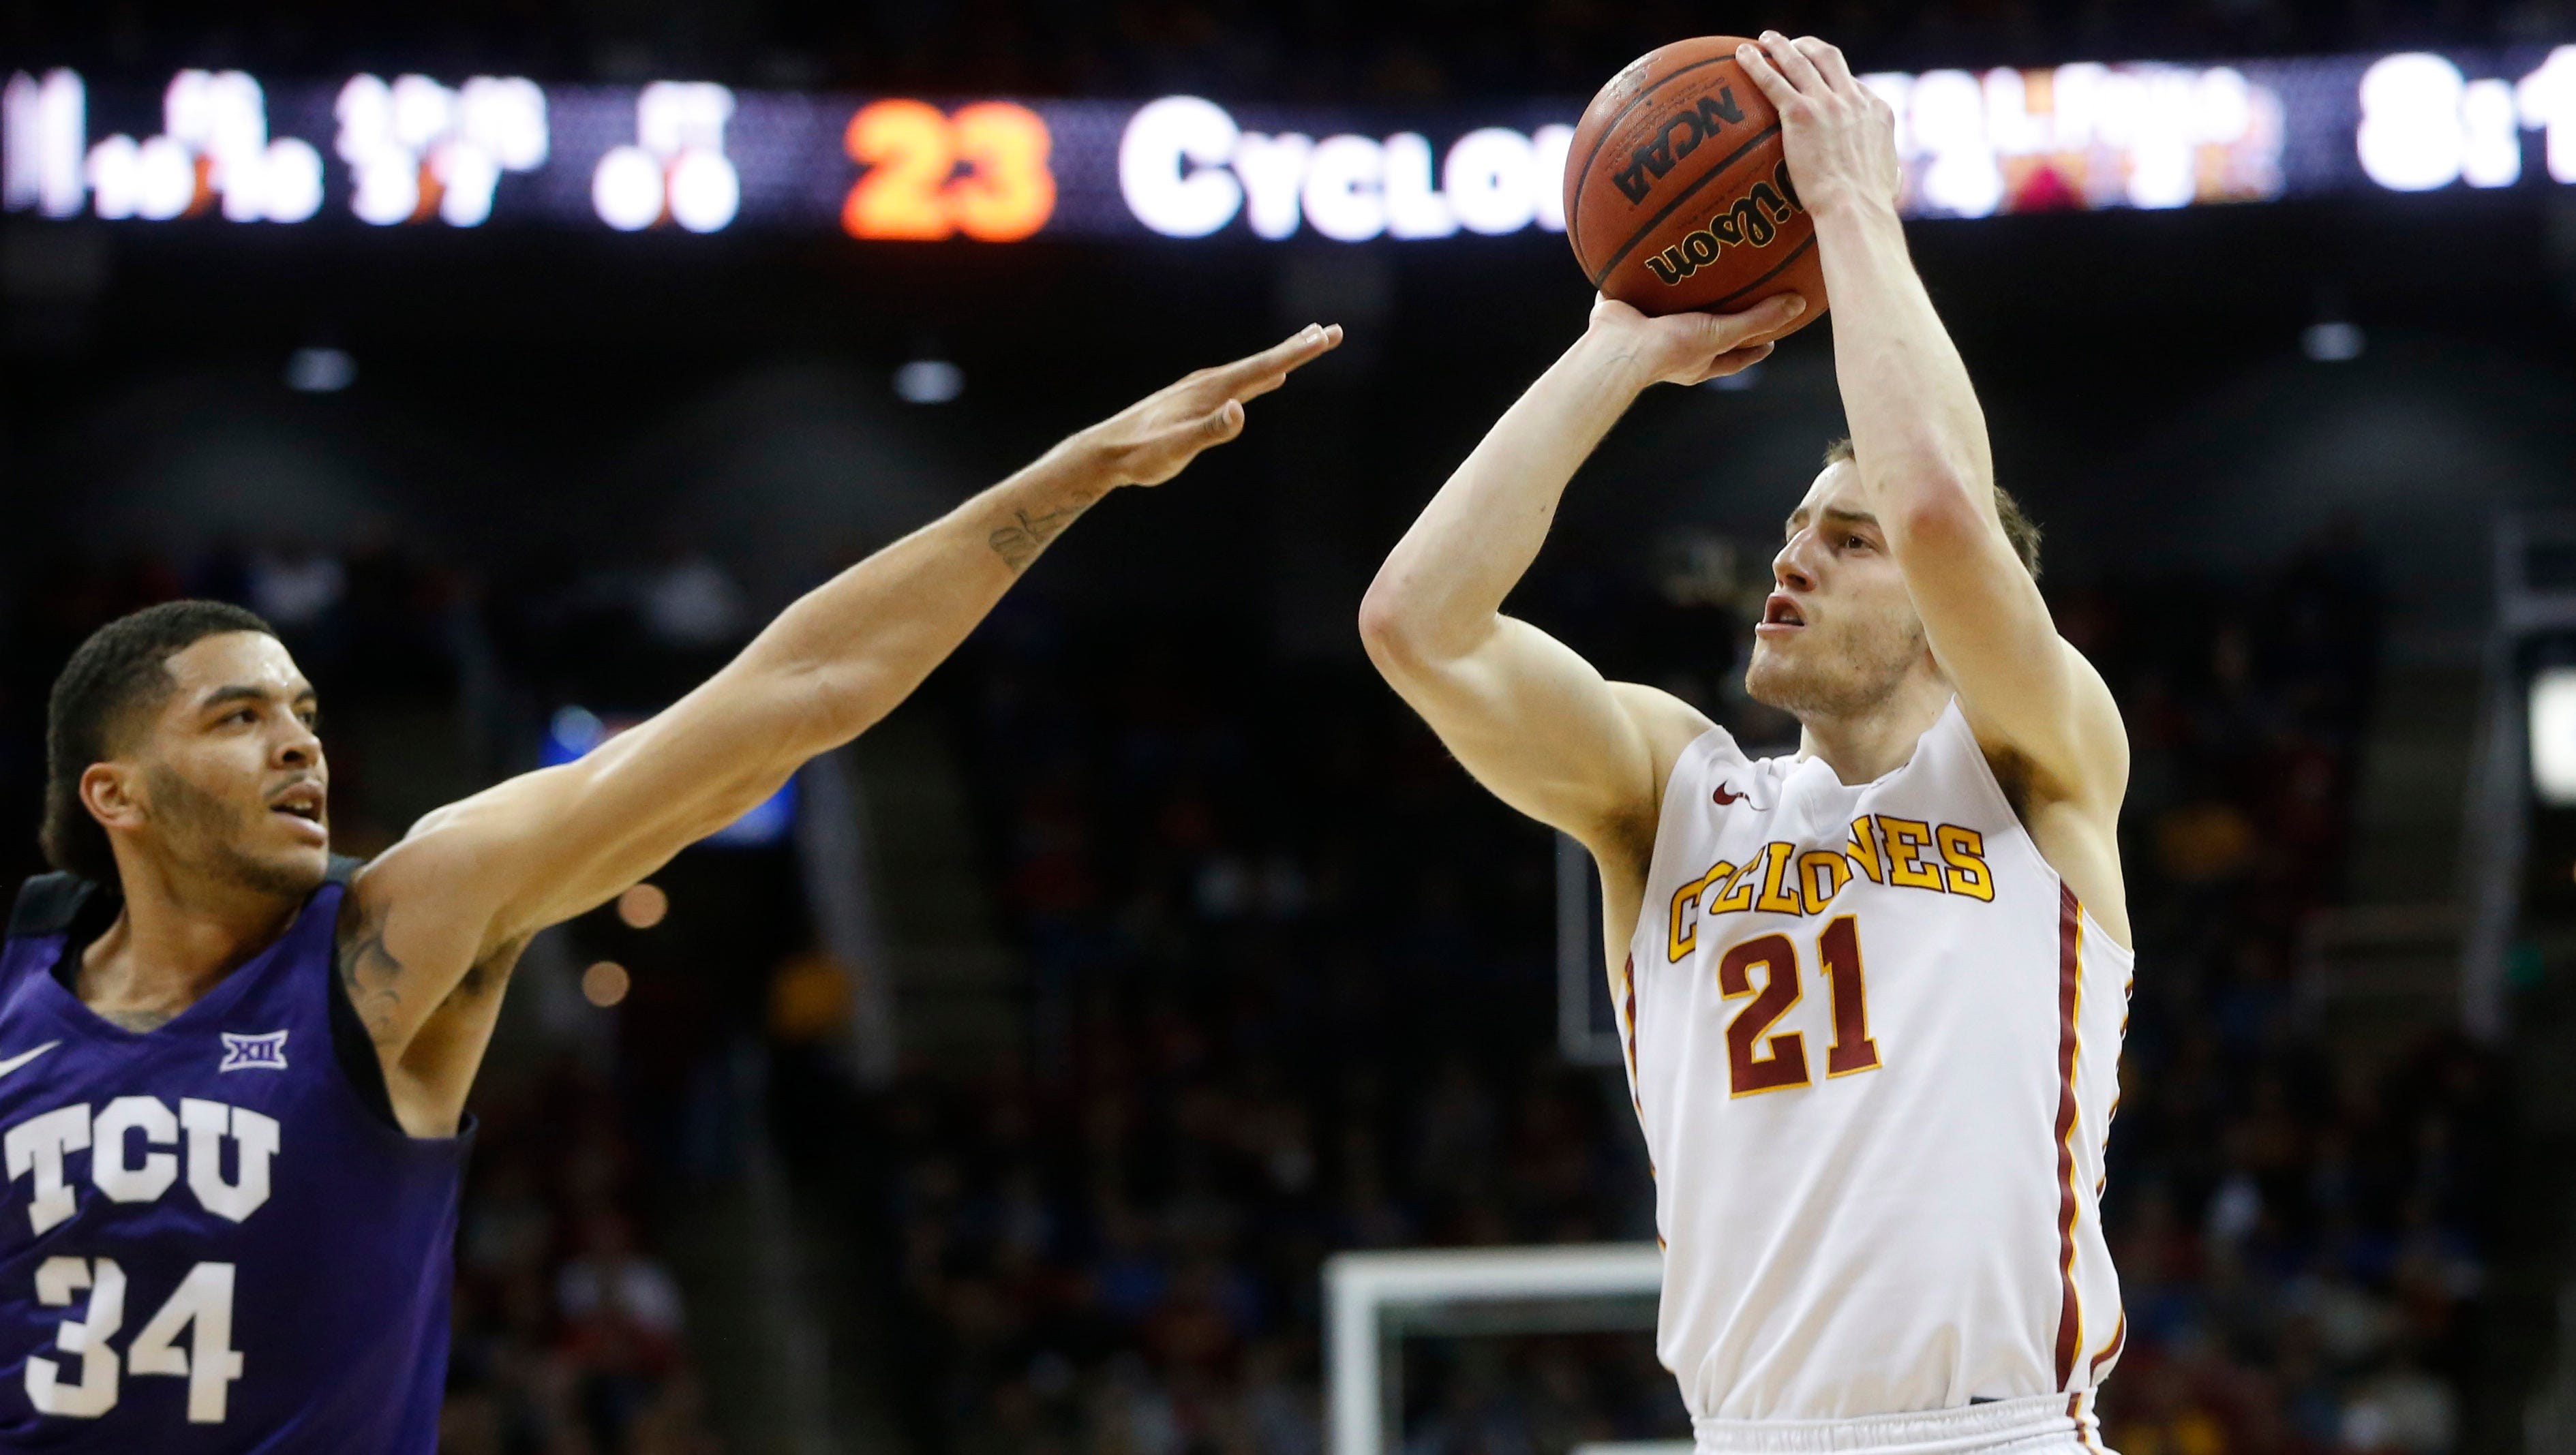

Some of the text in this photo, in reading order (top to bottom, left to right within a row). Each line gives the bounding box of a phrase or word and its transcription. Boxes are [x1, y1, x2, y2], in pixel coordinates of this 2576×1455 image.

[839, 98, 1057, 243] 23
[1612, 86, 1745, 205] NCAA
[1717, 914, 1882, 1100] 21
[4, 1095, 280, 1237] TCU
[25, 1255, 244, 1423] 34
